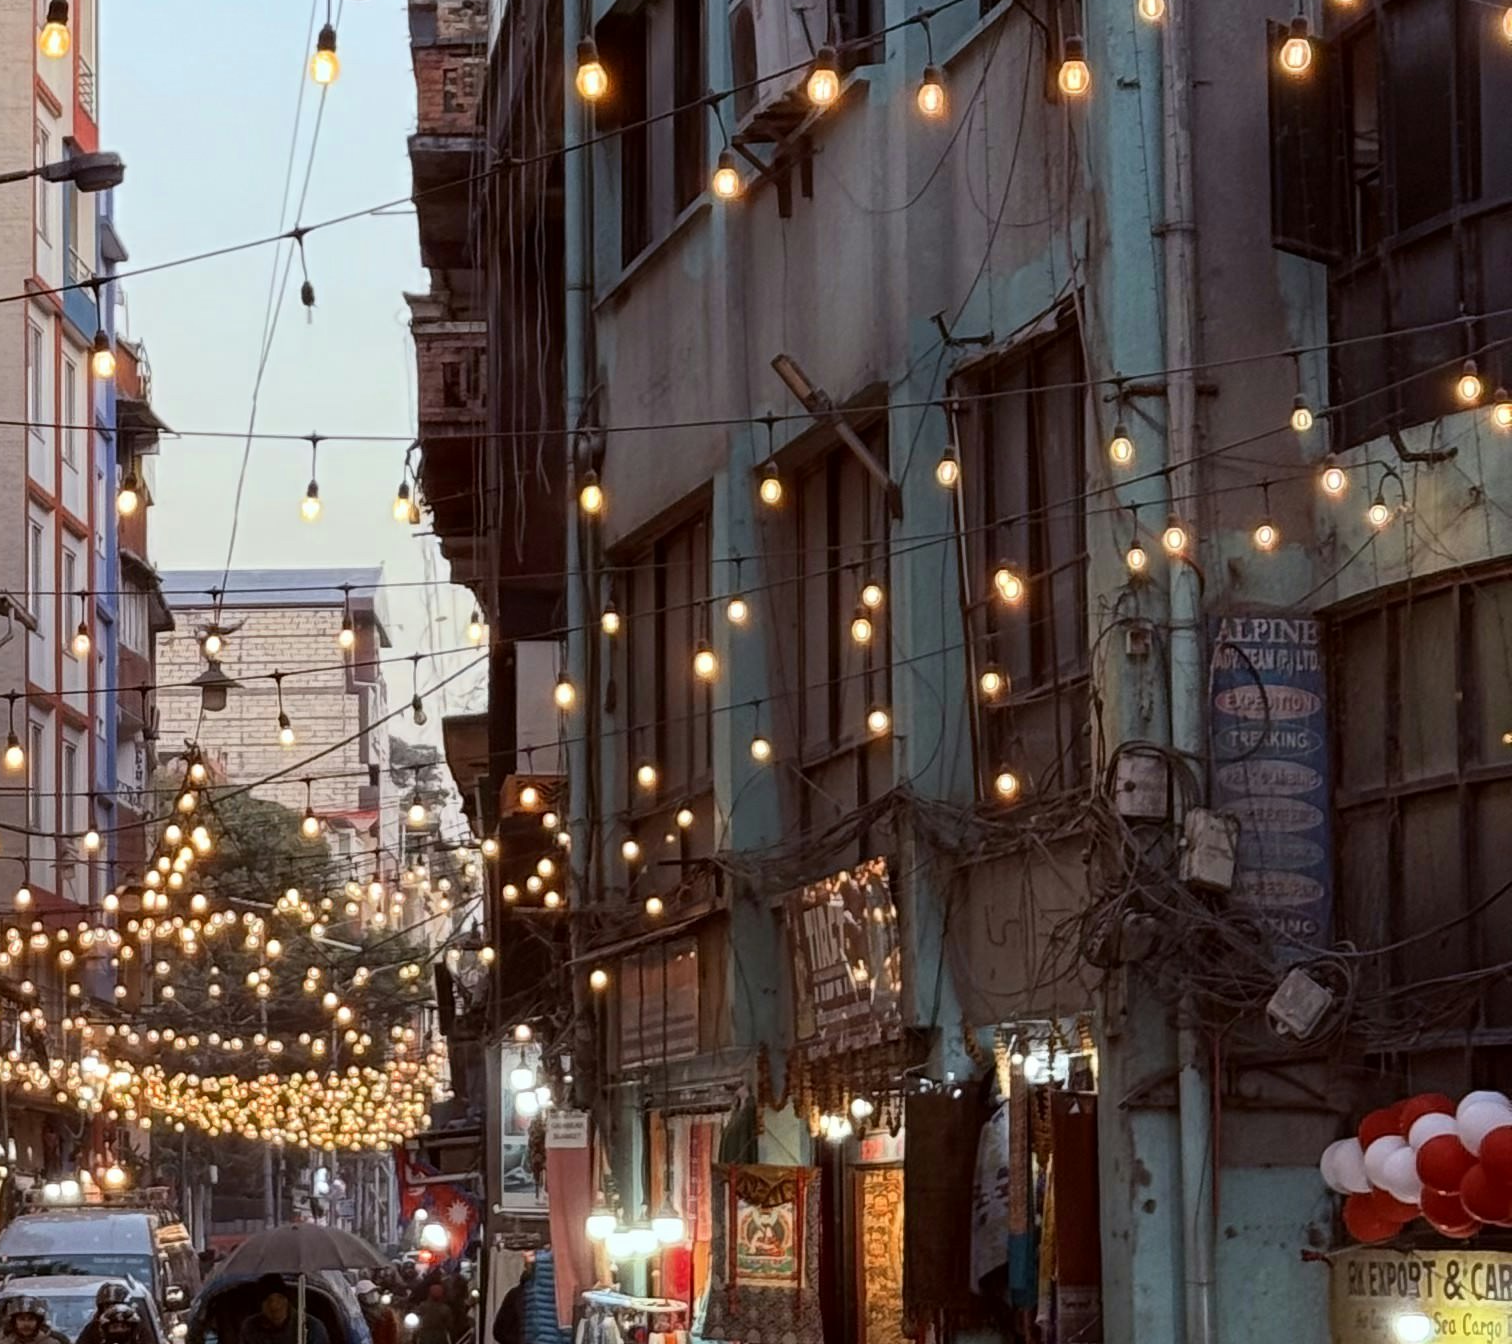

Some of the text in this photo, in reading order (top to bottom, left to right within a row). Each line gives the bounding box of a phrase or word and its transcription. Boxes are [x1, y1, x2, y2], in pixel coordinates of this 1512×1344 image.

[1215, 617, 1321, 644] ALPINE
[1242, 647, 1274, 671] TEAM
[1369, 1260, 1436, 1299] EXPORT
[1444, 1259, 1465, 1301] &
[1433, 1311, 1457, 1335] Sea
[1462, 1313, 1502, 1344] Cargo
